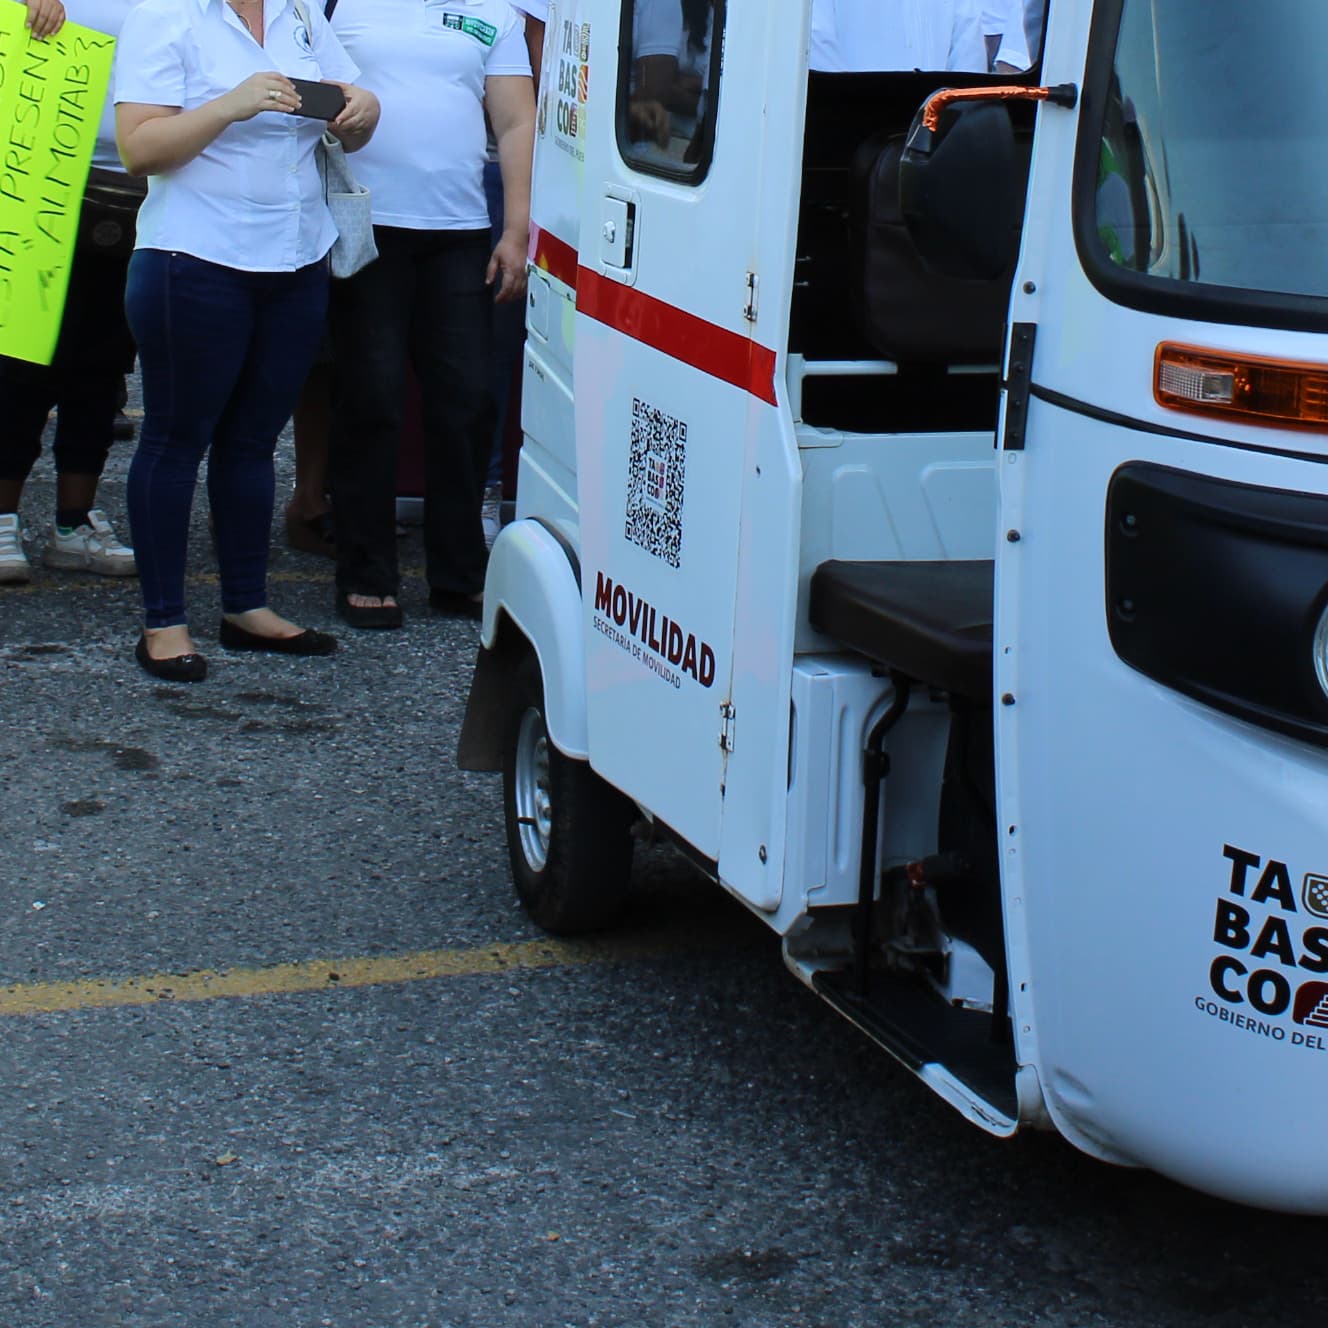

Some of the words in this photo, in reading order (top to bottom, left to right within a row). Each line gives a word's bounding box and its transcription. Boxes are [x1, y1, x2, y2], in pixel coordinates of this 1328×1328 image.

[558, 58, 578, 99] BAS
[0, 30, 51, 203] PRESENT
[594, 571, 716, 688] MOVILIDAD
[632, 644, 642, 661] DE
[643, 652, 681, 690] MOVILIDAD
[1223, 842, 1298, 914] TA
[1209, 954, 1292, 1016] CO
[1194, 995, 1286, 1041] GOBIERNO
[1291, 1031, 1326, 1051] DEL
